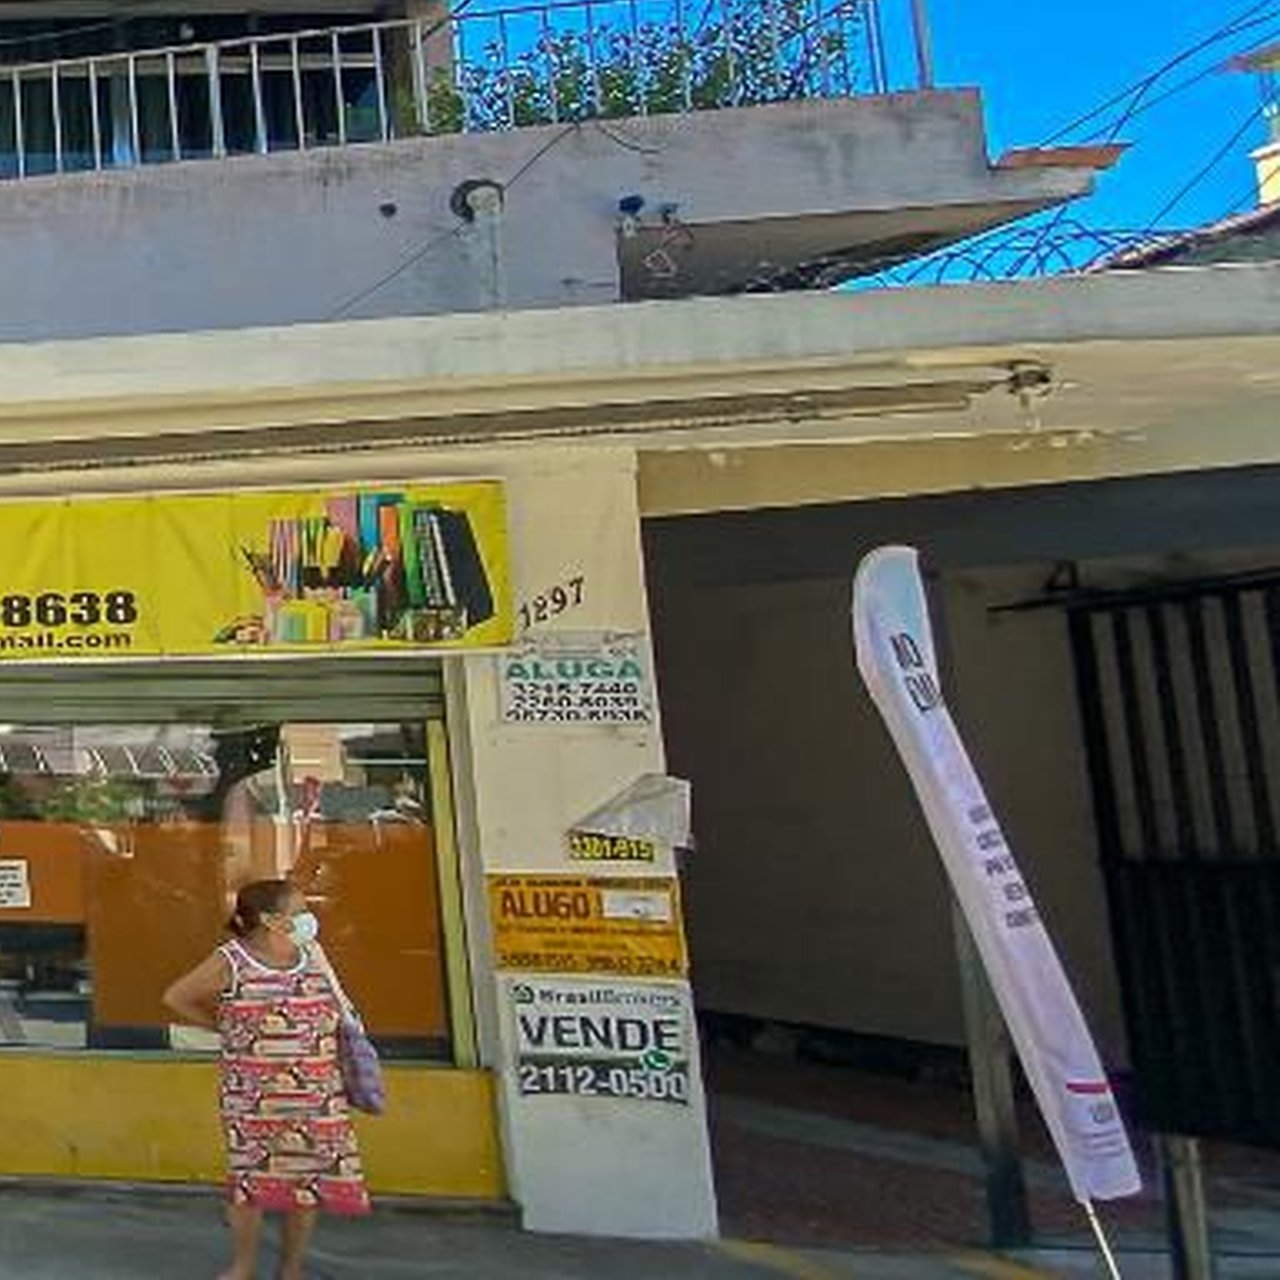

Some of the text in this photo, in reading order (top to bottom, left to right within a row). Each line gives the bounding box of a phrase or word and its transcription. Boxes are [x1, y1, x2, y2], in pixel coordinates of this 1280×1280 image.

[520, 575, 584, 631] 1297
[506, 660, 641, 679] ALUGA
[501, 891, 589, 919] ALUGO
[519, 1015, 681, 1052] VENDE
[520, 1065, 688, 1098] 2112-0500
